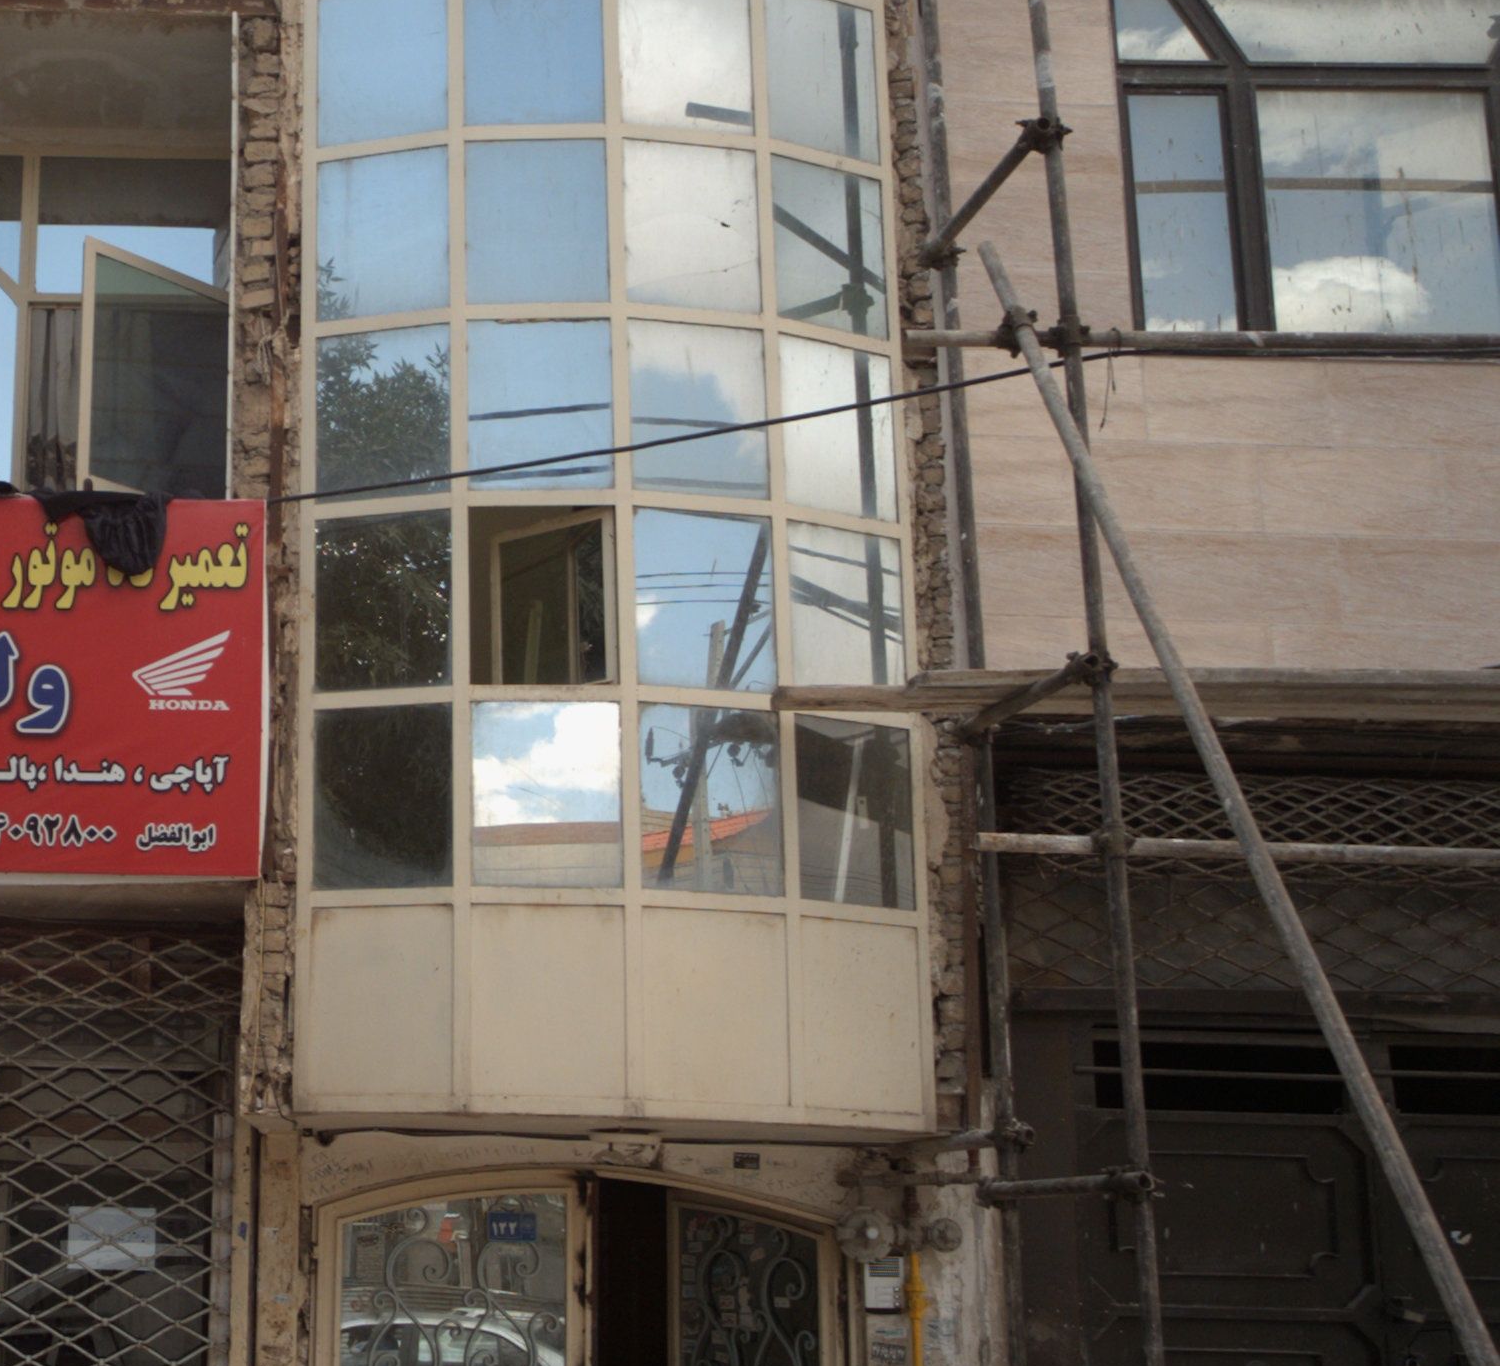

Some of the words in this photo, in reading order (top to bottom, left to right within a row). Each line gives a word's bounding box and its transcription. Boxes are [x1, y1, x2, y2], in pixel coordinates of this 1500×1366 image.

[2, 520, 98, 611] موتور
[148, 697, 232, 713] HONDA
[53, 756, 127, 784] هندا
[149, 754, 230, 793] آپاچی
[136, 822, 217, 852] ابوالفضل
